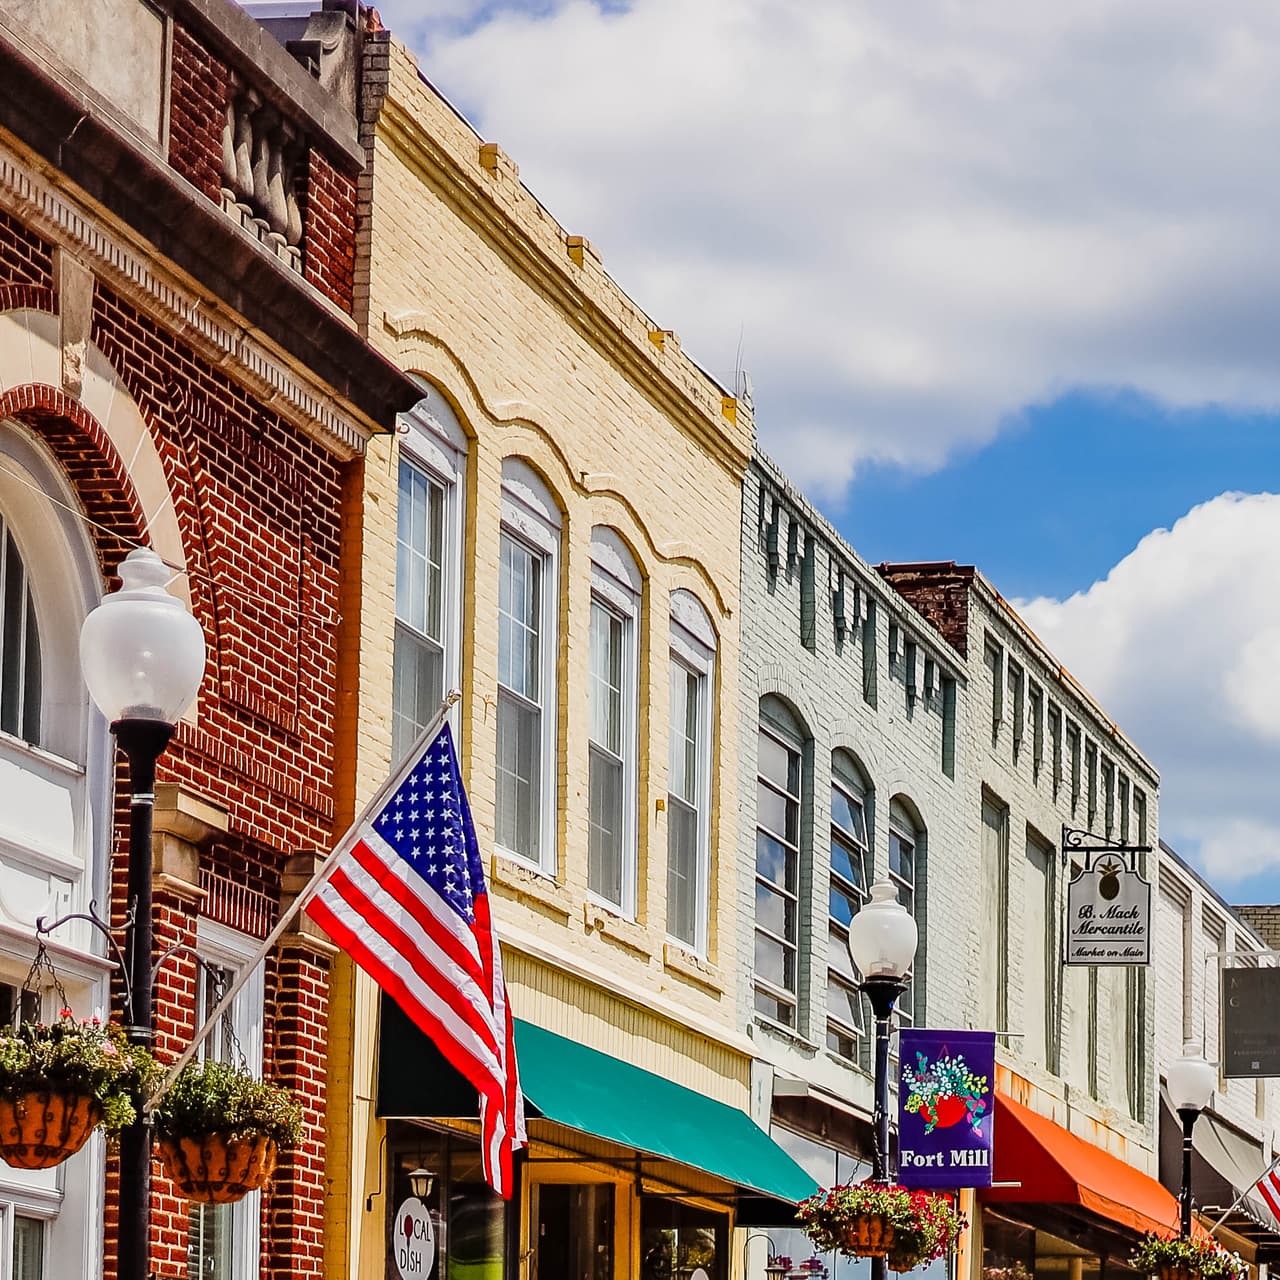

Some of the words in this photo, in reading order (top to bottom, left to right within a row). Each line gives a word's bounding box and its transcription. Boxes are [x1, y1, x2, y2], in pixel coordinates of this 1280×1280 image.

[1078, 904, 1096, 919] B.
[1099, 904, 1140, 919] Mack
[1072, 920, 1145, 935] Mercantile
[1072, 946, 1105, 957] Market
[1119, 946, 1144, 957] Main
[901, 1150, 944, 1167] Fort
[949, 1149, 989, 1167] Mill
